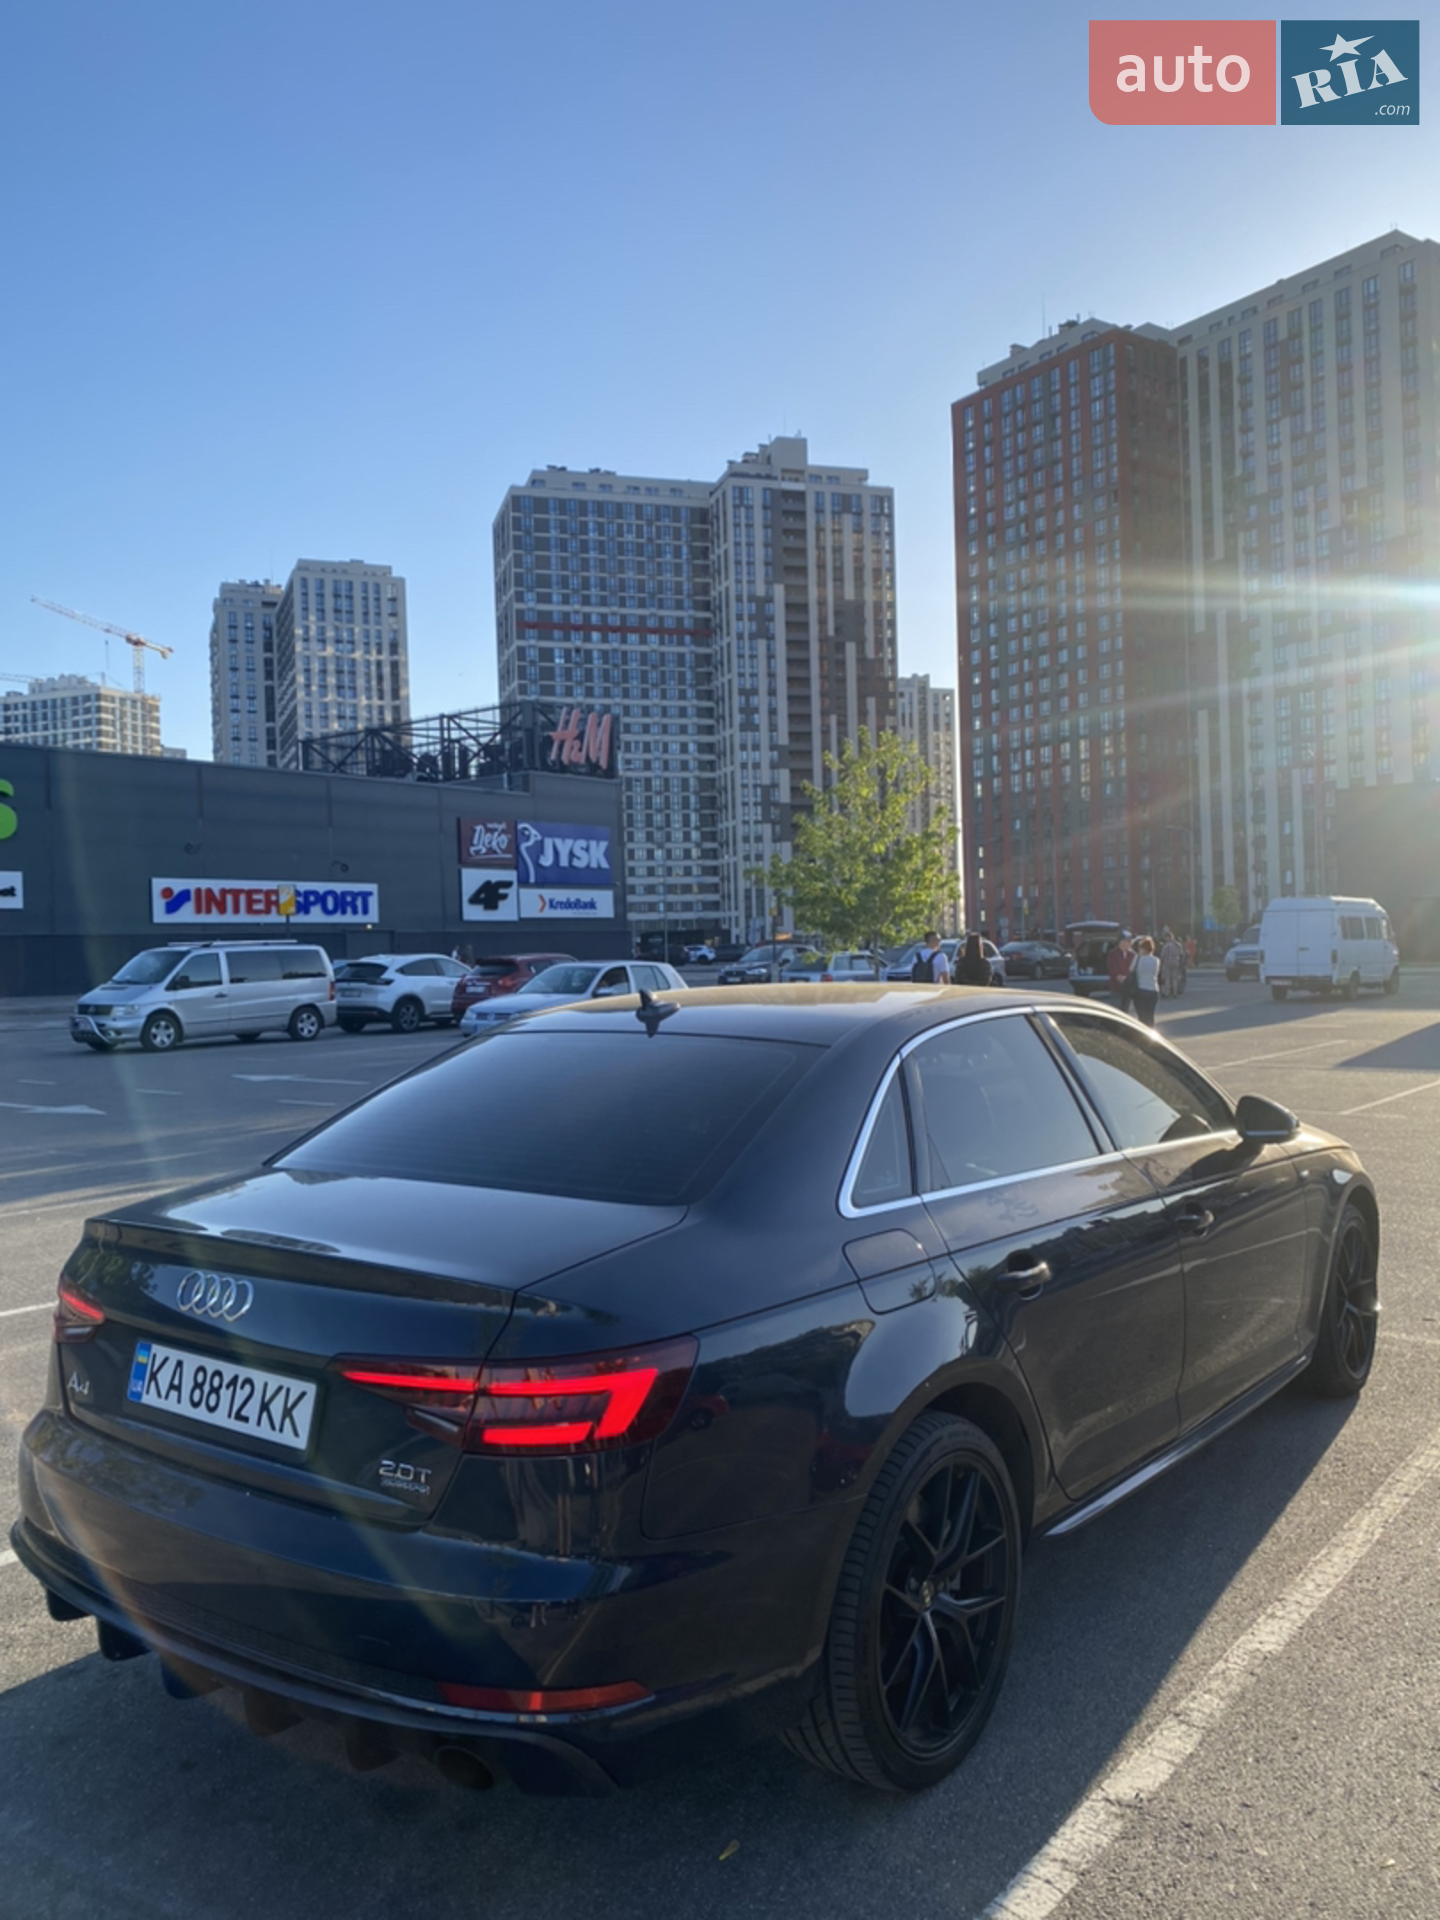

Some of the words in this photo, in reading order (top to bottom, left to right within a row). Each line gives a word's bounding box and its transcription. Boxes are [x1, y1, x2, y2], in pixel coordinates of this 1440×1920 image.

[550, 706, 612, 770] H&M
[538, 836, 610, 869] JYSK
[468, 879, 514, 912] 4F
